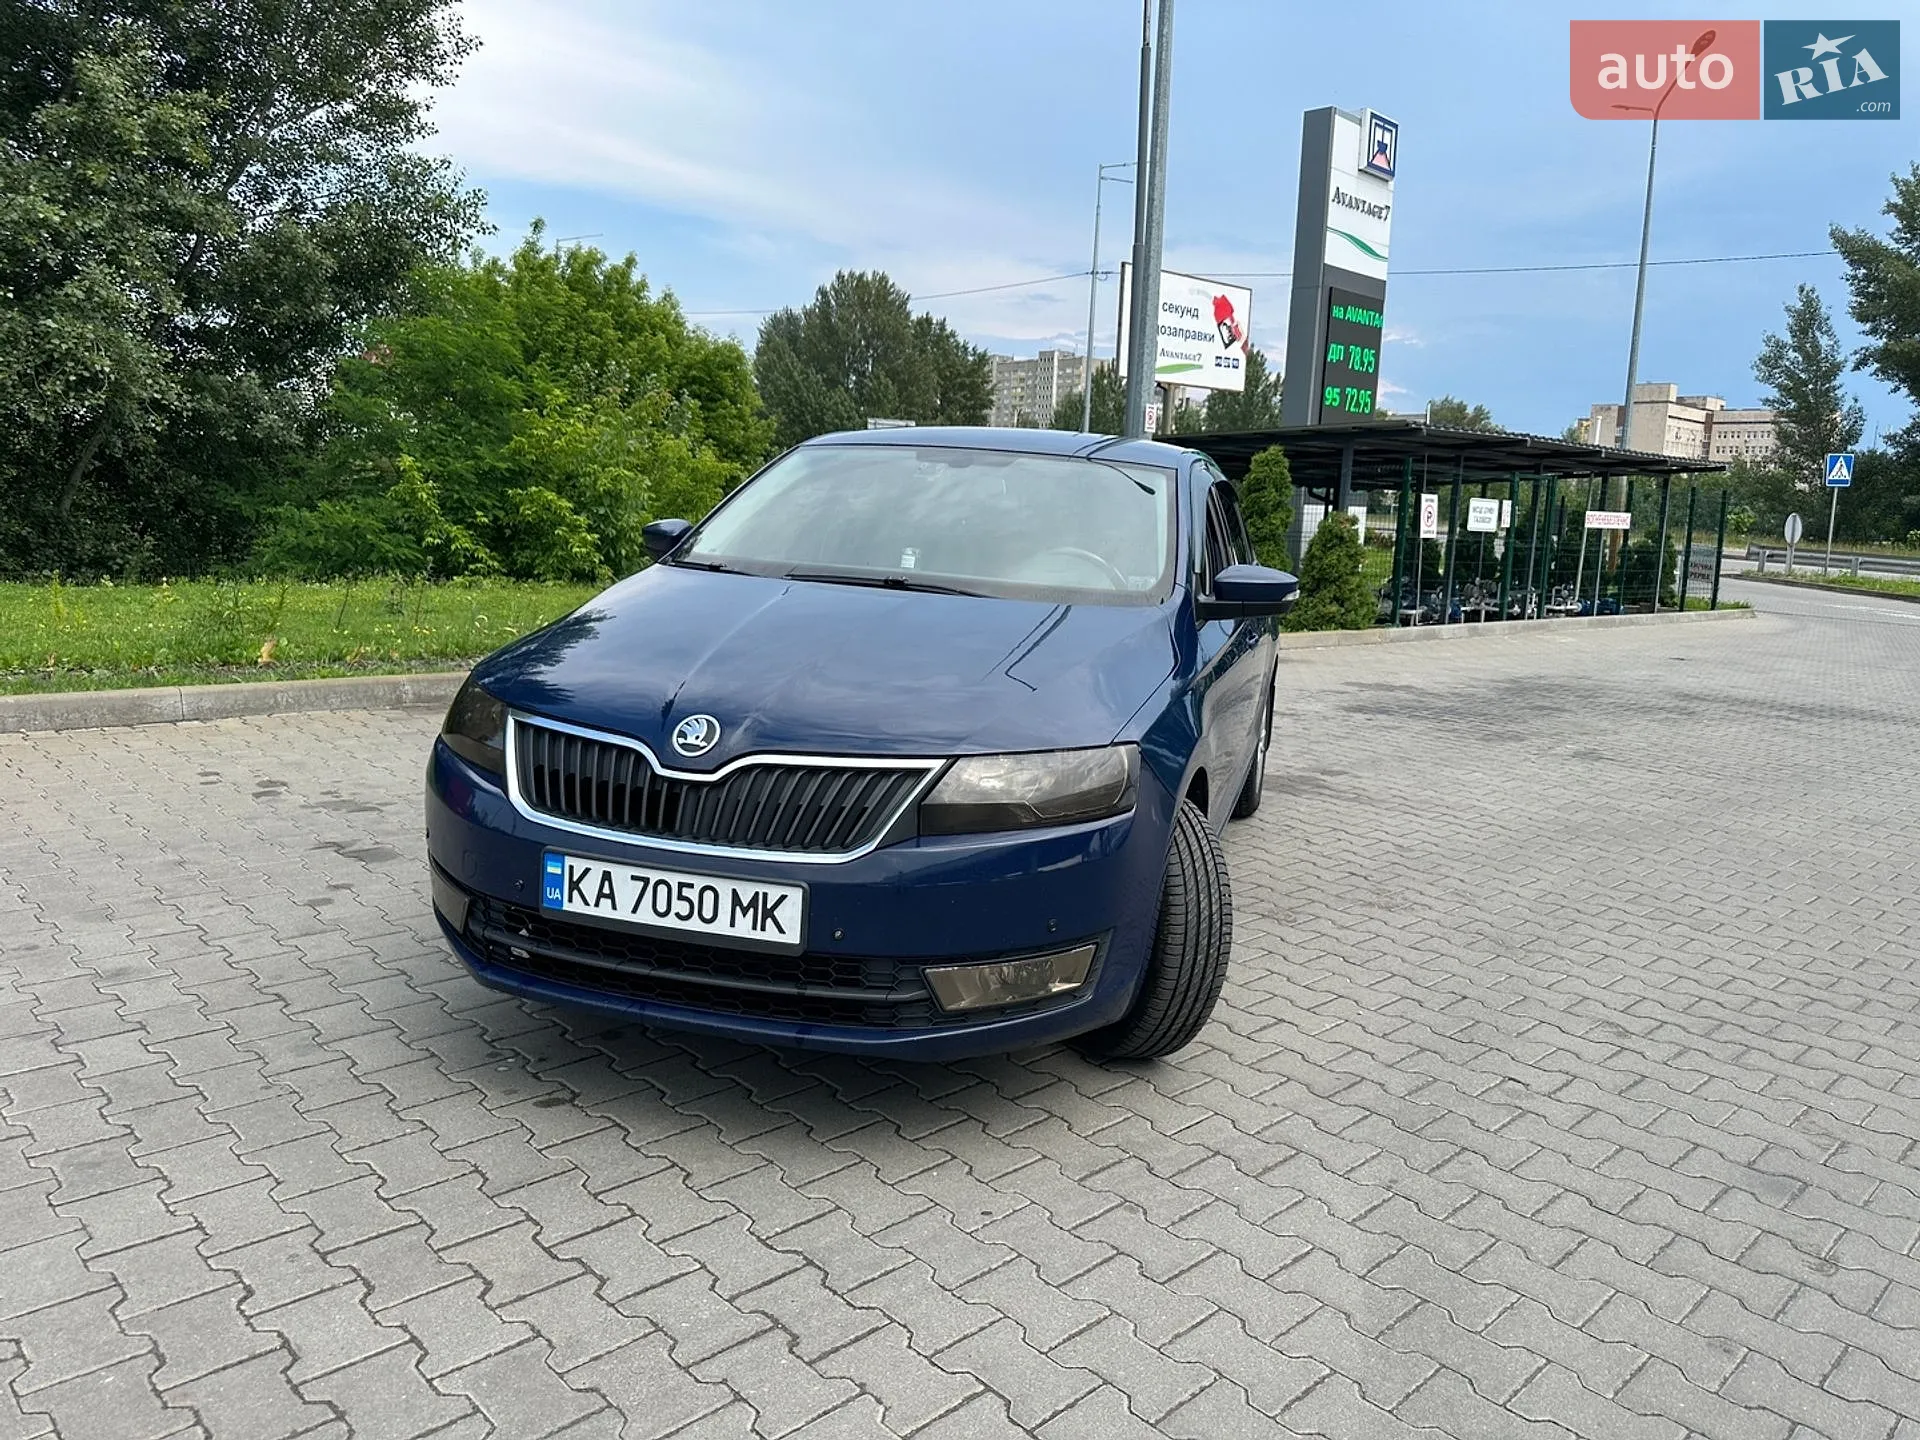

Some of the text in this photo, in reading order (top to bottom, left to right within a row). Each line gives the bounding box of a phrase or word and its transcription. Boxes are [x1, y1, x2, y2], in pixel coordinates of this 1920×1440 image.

[1161, 302, 1199, 320] секунд
[1332, 305, 1344, 320] на
[1157, 324, 1215, 343] озаправки
[1348, 345, 1376, 373] 78.95
[1324, 386, 1371, 414] 95 72.95
[546, 886, 562, 901] UA
[567, 864, 789, 935] KA 7050 MK
